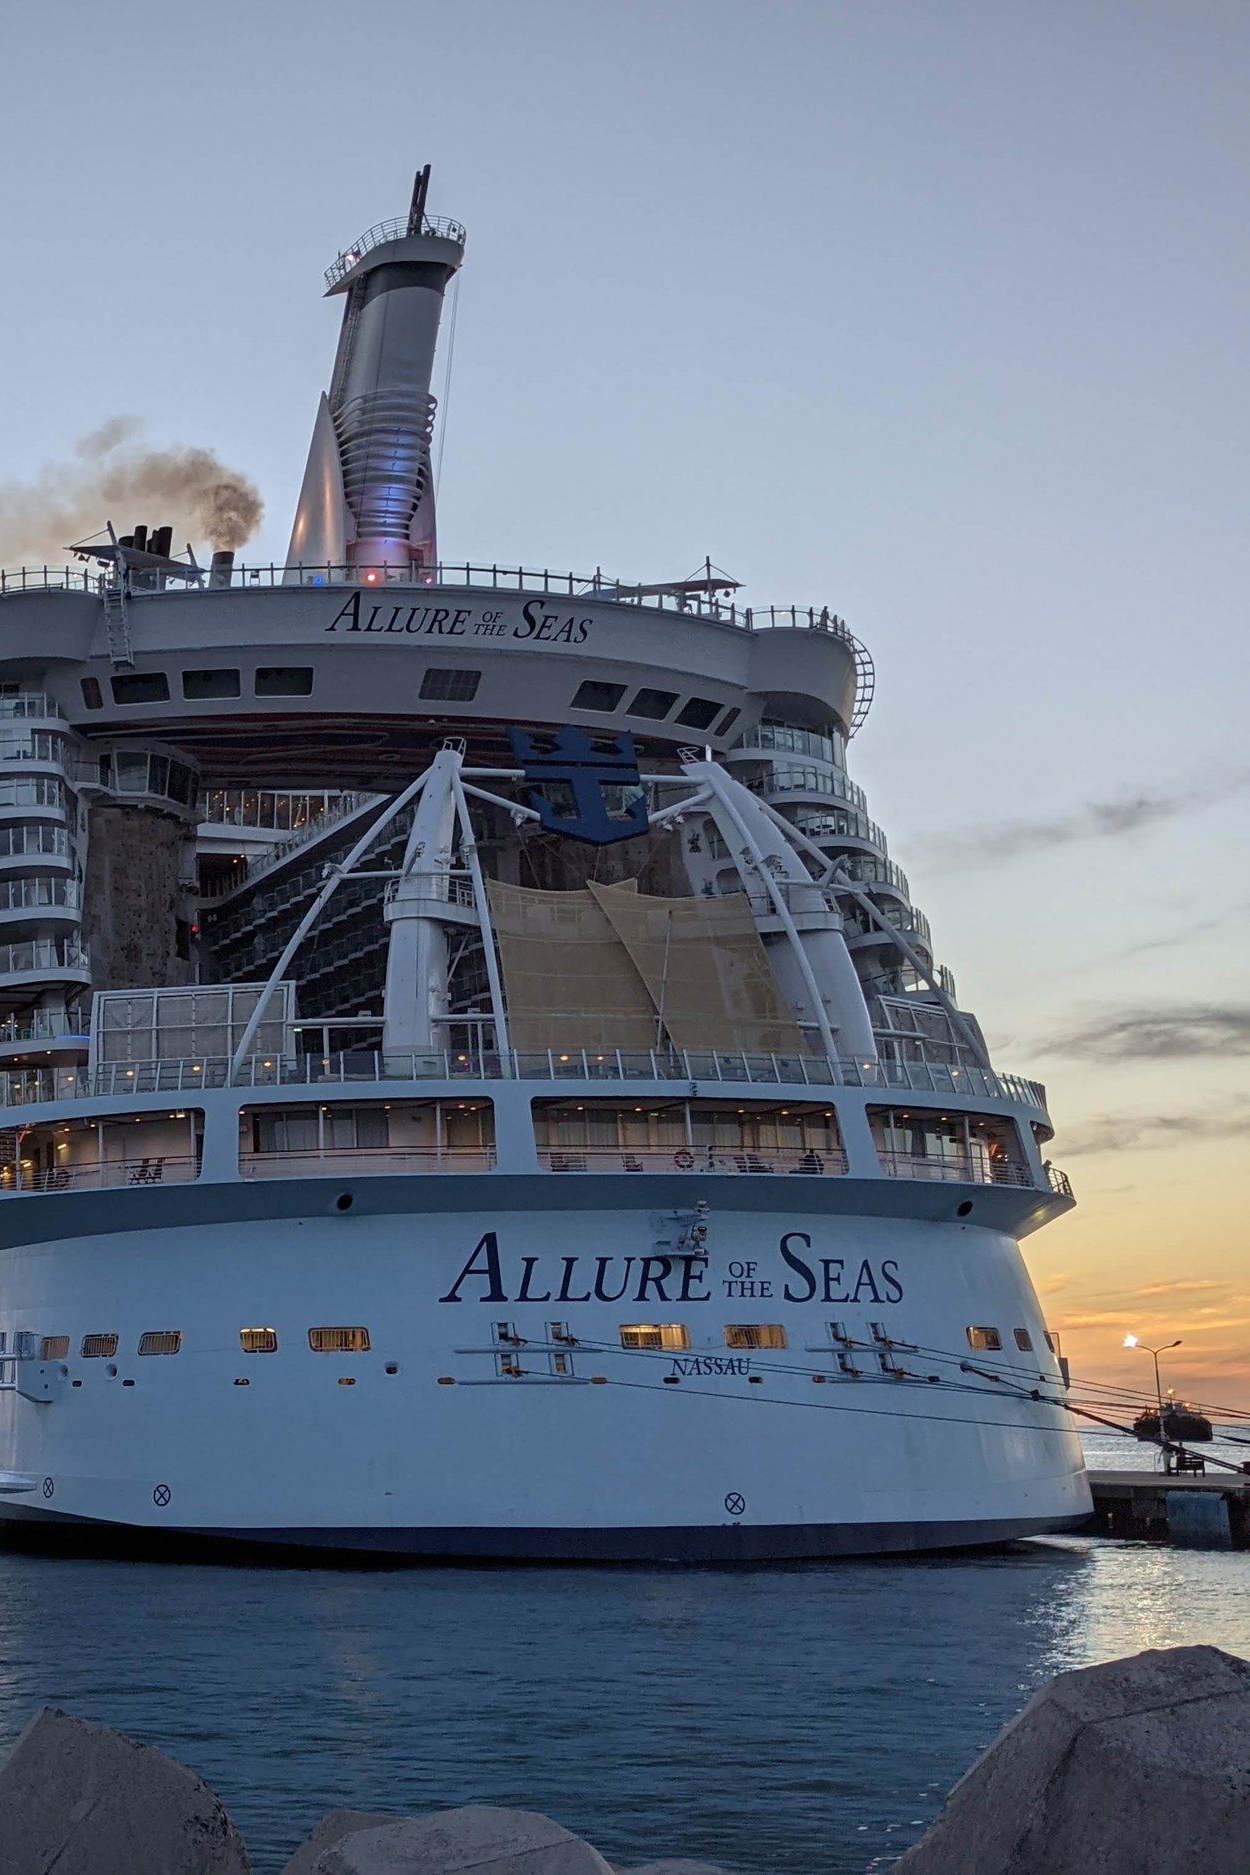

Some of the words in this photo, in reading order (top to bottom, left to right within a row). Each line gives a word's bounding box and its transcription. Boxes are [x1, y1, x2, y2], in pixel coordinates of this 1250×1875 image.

[481, 610, 504, 624] OF
[473, 623, 506, 637] THE
[728, 1261, 758, 1279] OF
[722, 1280, 774, 1299] THE
[670, 1357, 752, 1377] NASSAU
